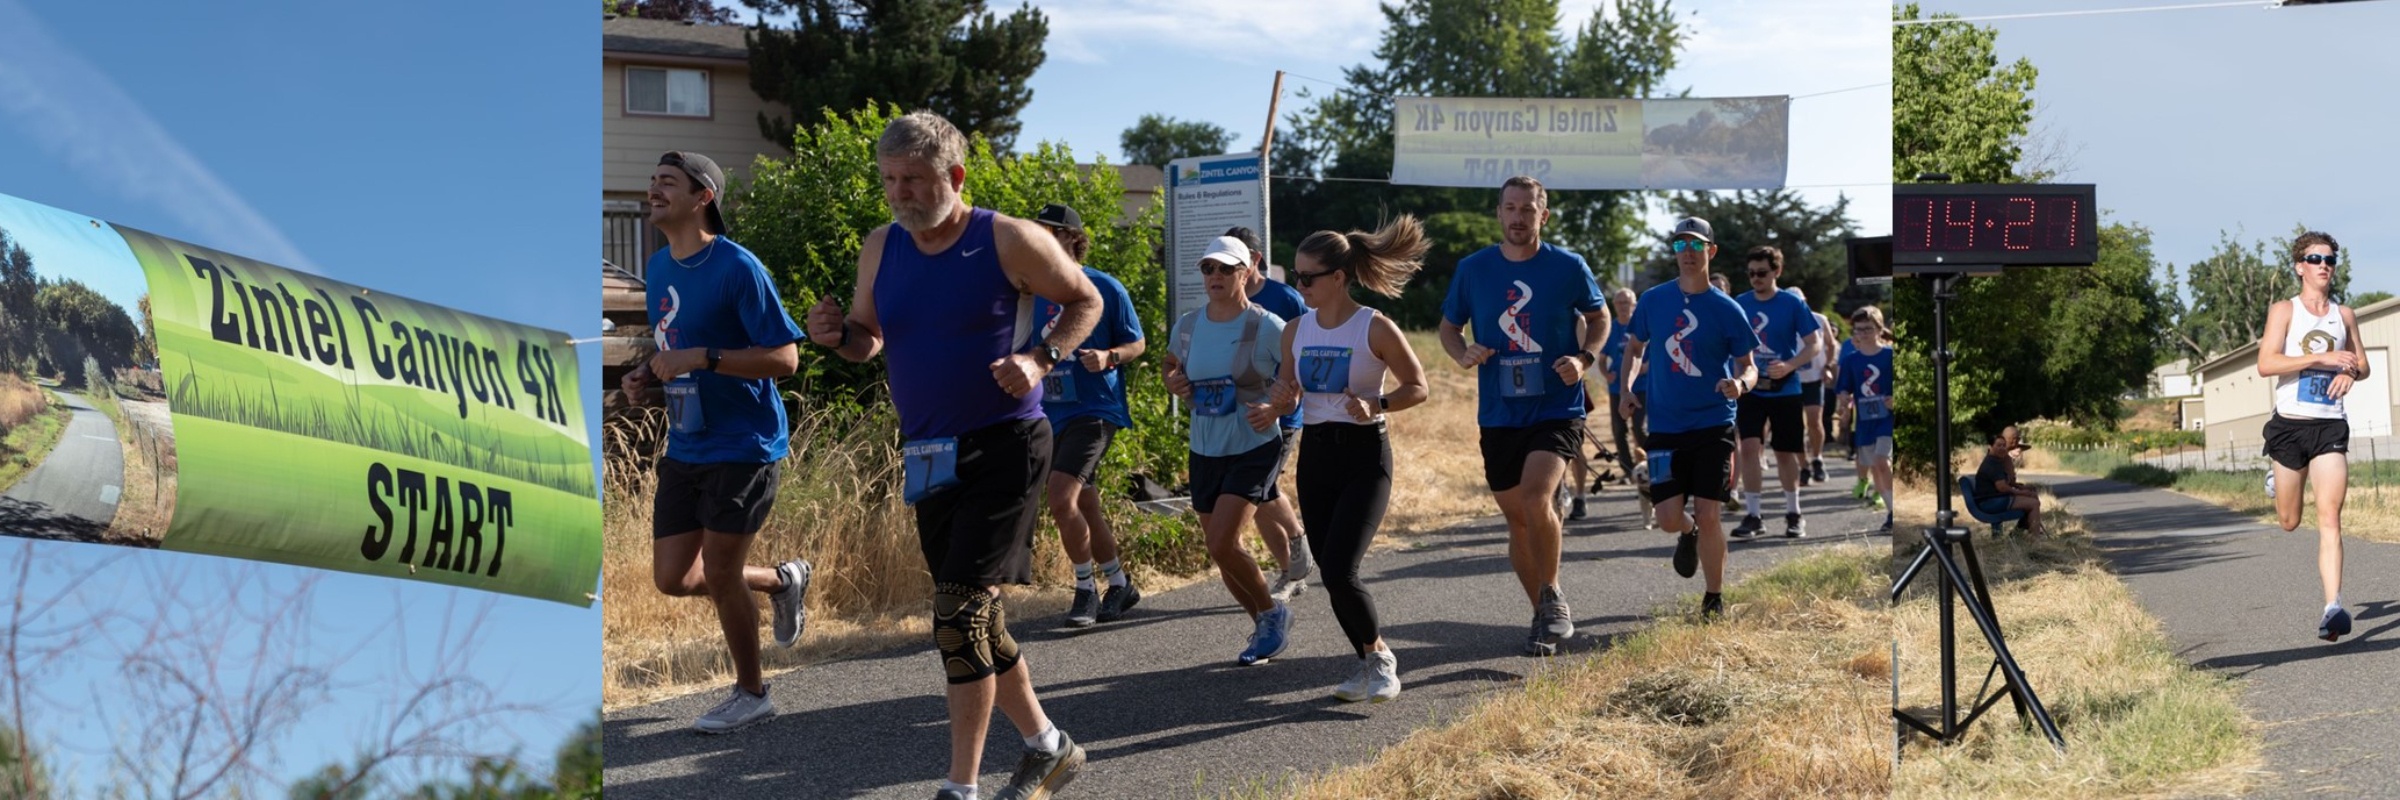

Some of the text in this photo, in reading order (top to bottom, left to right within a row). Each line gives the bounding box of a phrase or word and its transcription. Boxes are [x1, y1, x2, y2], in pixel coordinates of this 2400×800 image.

[1201, 165, 1258, 178] ZINTEL CANYON
[1178, 192, 1195, 200] Rules
[1203, 189, 1242, 200] Regulations
[185, 254, 567, 427] Zintel Canyon 4K
[1311, 357, 1335, 382] 27
[1512, 365, 1524, 388] 6
[2309, 377, 2329, 397] 58
[920, 455, 933, 491] 7
[361, 462, 513, 578] START
